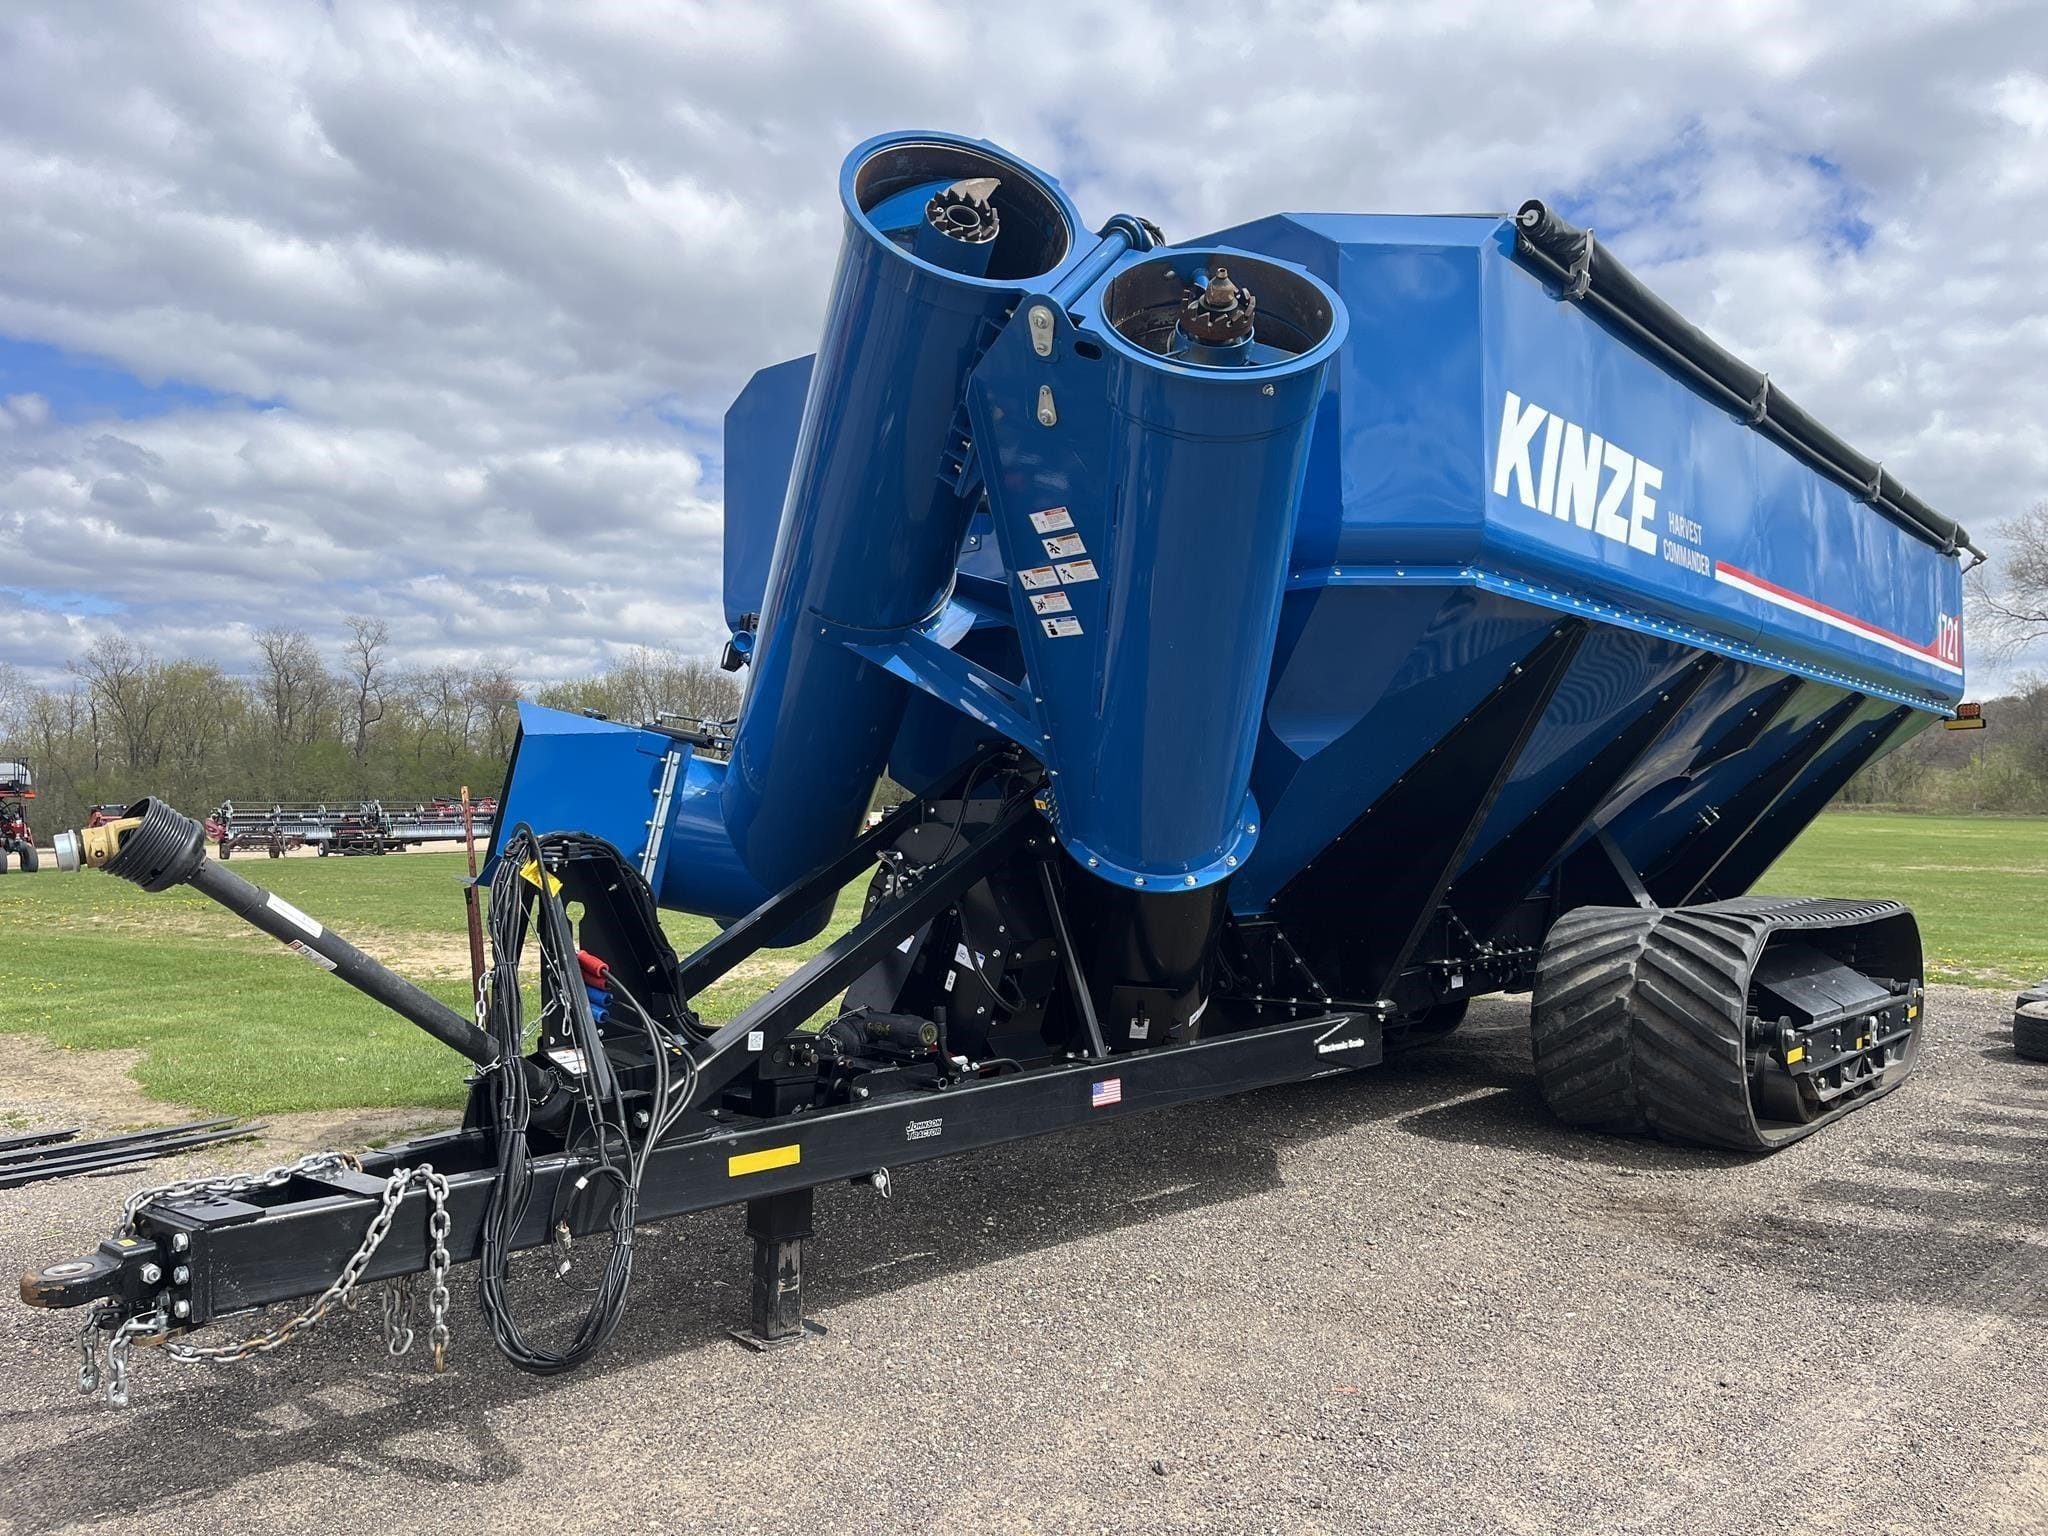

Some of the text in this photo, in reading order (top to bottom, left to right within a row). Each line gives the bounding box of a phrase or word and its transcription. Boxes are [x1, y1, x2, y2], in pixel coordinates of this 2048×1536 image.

[1493, 390, 1663, 556] KINZE
[1668, 511, 1702, 545] HARVEST
[1663, 538, 1711, 577] COMMANDER
[1938, 611, 1958, 662] 1721
[906, 1118, 942, 1132] JOHNSON
[907, 1127, 942, 1140] TRACTOR
